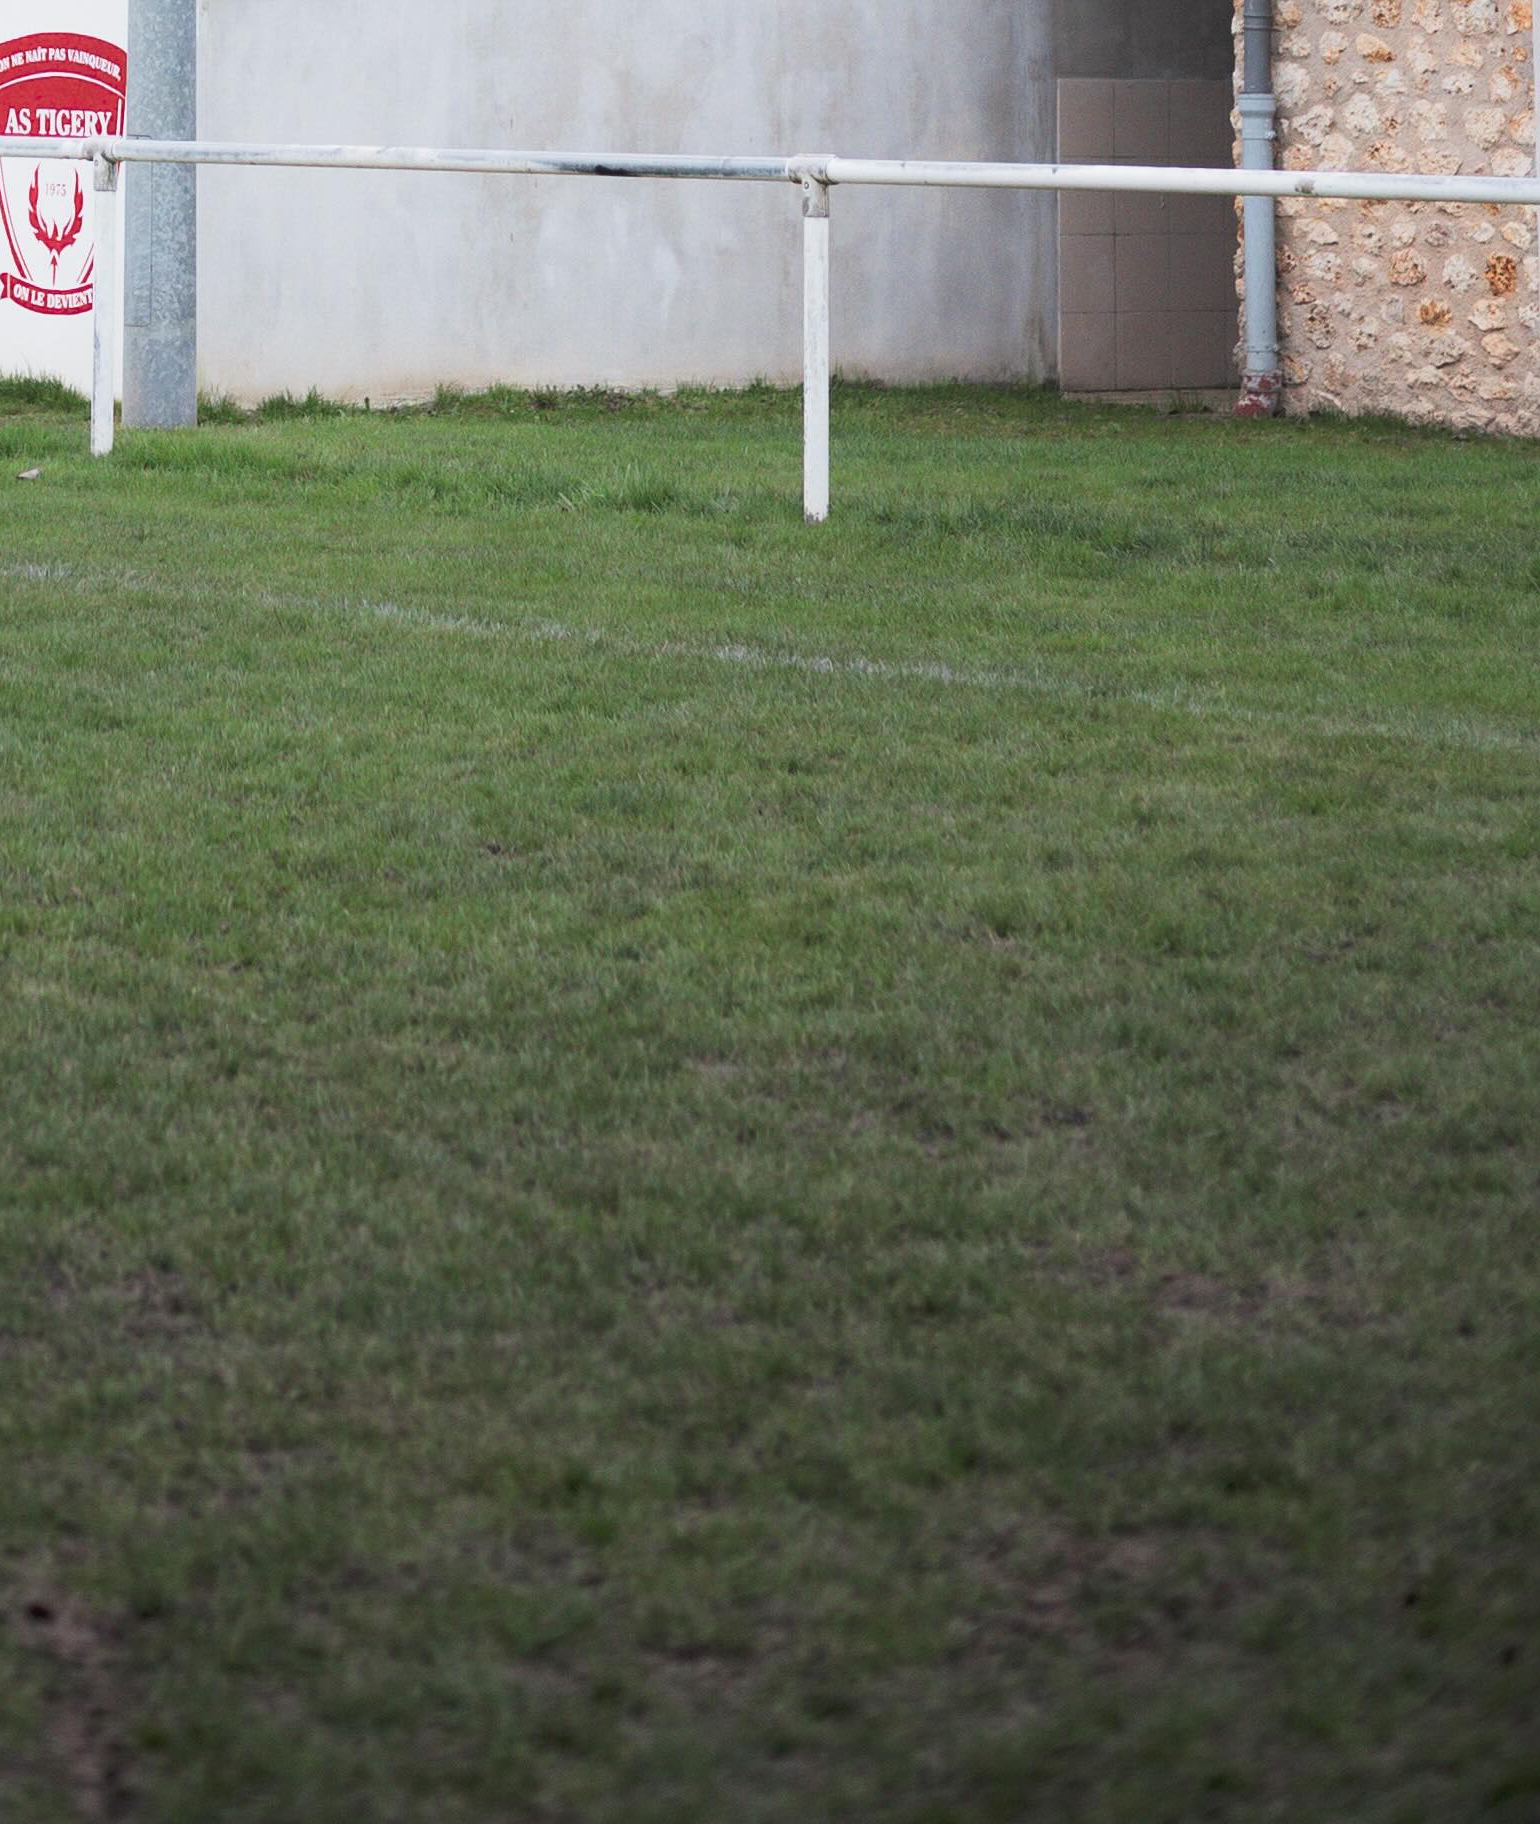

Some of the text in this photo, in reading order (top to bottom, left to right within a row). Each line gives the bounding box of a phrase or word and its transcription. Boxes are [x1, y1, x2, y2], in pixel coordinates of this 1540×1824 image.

[11, 51, 24, 67] NE
[48, 48, 66, 62] PAS
[4, 108, 112, 137] AS TIGERY
[13, 284, 93, 308] ON LE DEVIENT
